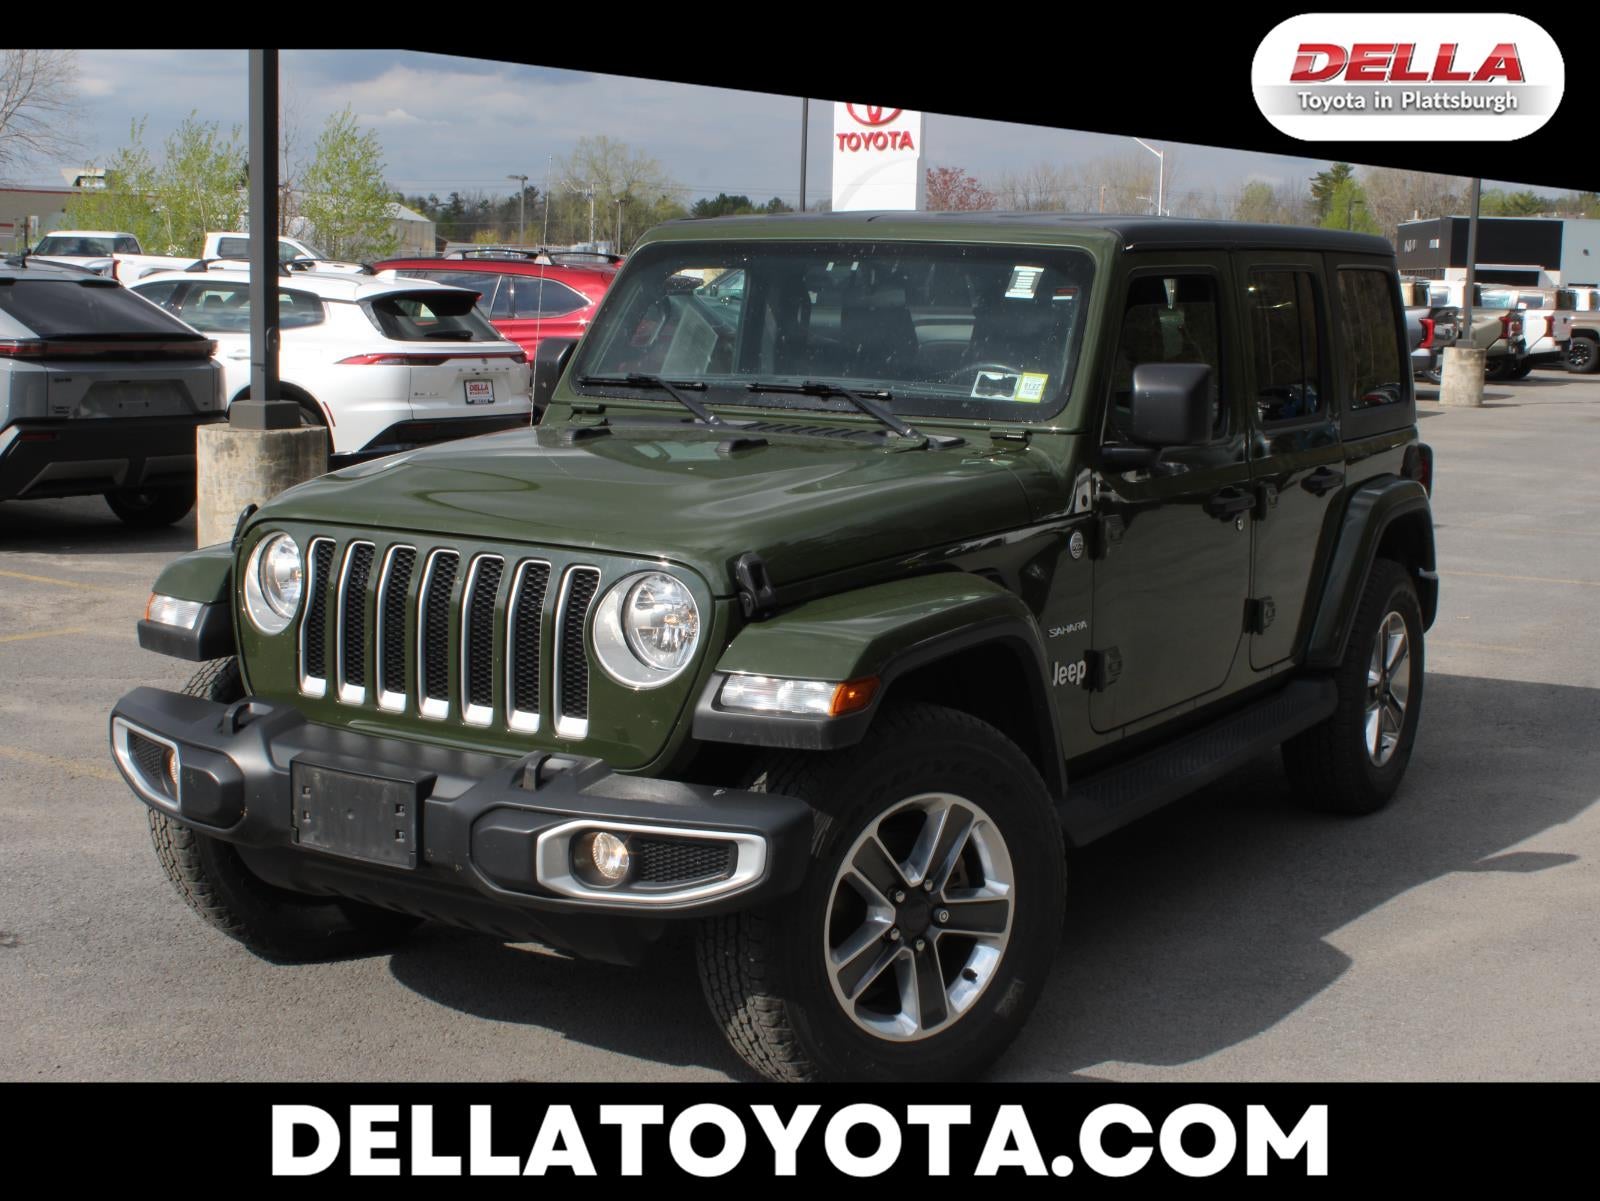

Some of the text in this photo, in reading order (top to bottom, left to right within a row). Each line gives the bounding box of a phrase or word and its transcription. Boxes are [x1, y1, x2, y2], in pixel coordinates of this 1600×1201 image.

[836, 131, 915, 152] TOYOTA
[1048, 620, 1088, 638] SAHARA
[1052, 659, 1087, 687] Jeep
